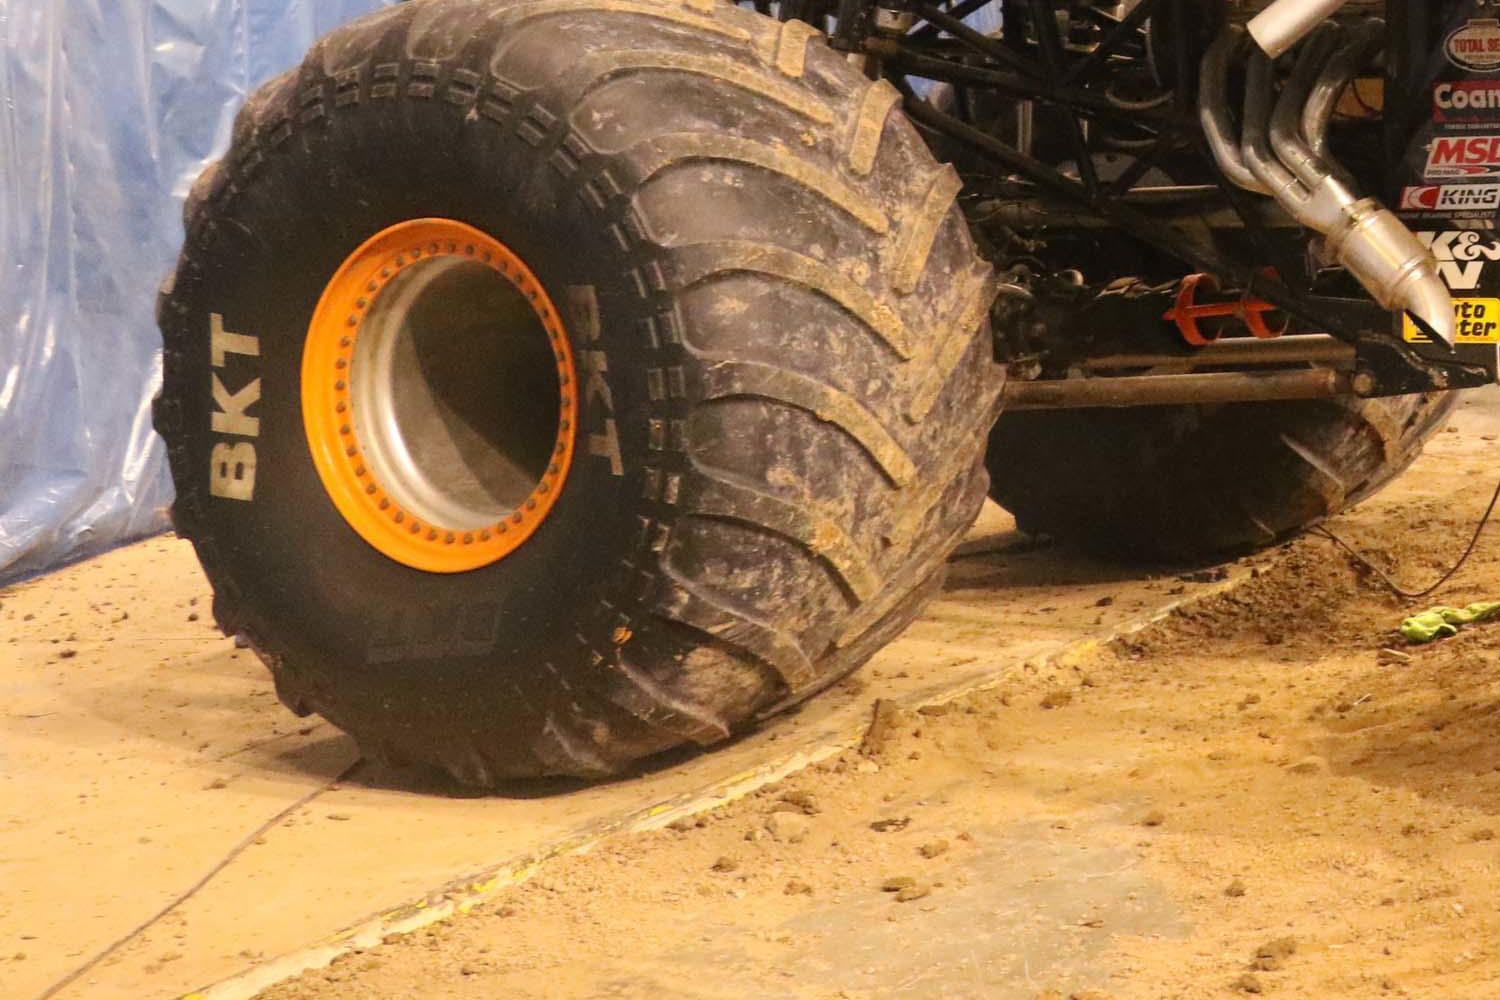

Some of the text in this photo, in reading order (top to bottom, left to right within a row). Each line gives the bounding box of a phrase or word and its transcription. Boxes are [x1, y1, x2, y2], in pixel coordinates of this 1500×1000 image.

[1454, 39, 1484, 53] TOTAL
[1441, 188, 1498, 205] KING
[1455, 302, 1486, 319] uto
[1457, 318, 1497, 337] ter
[210, 313, 262, 501] BKT
